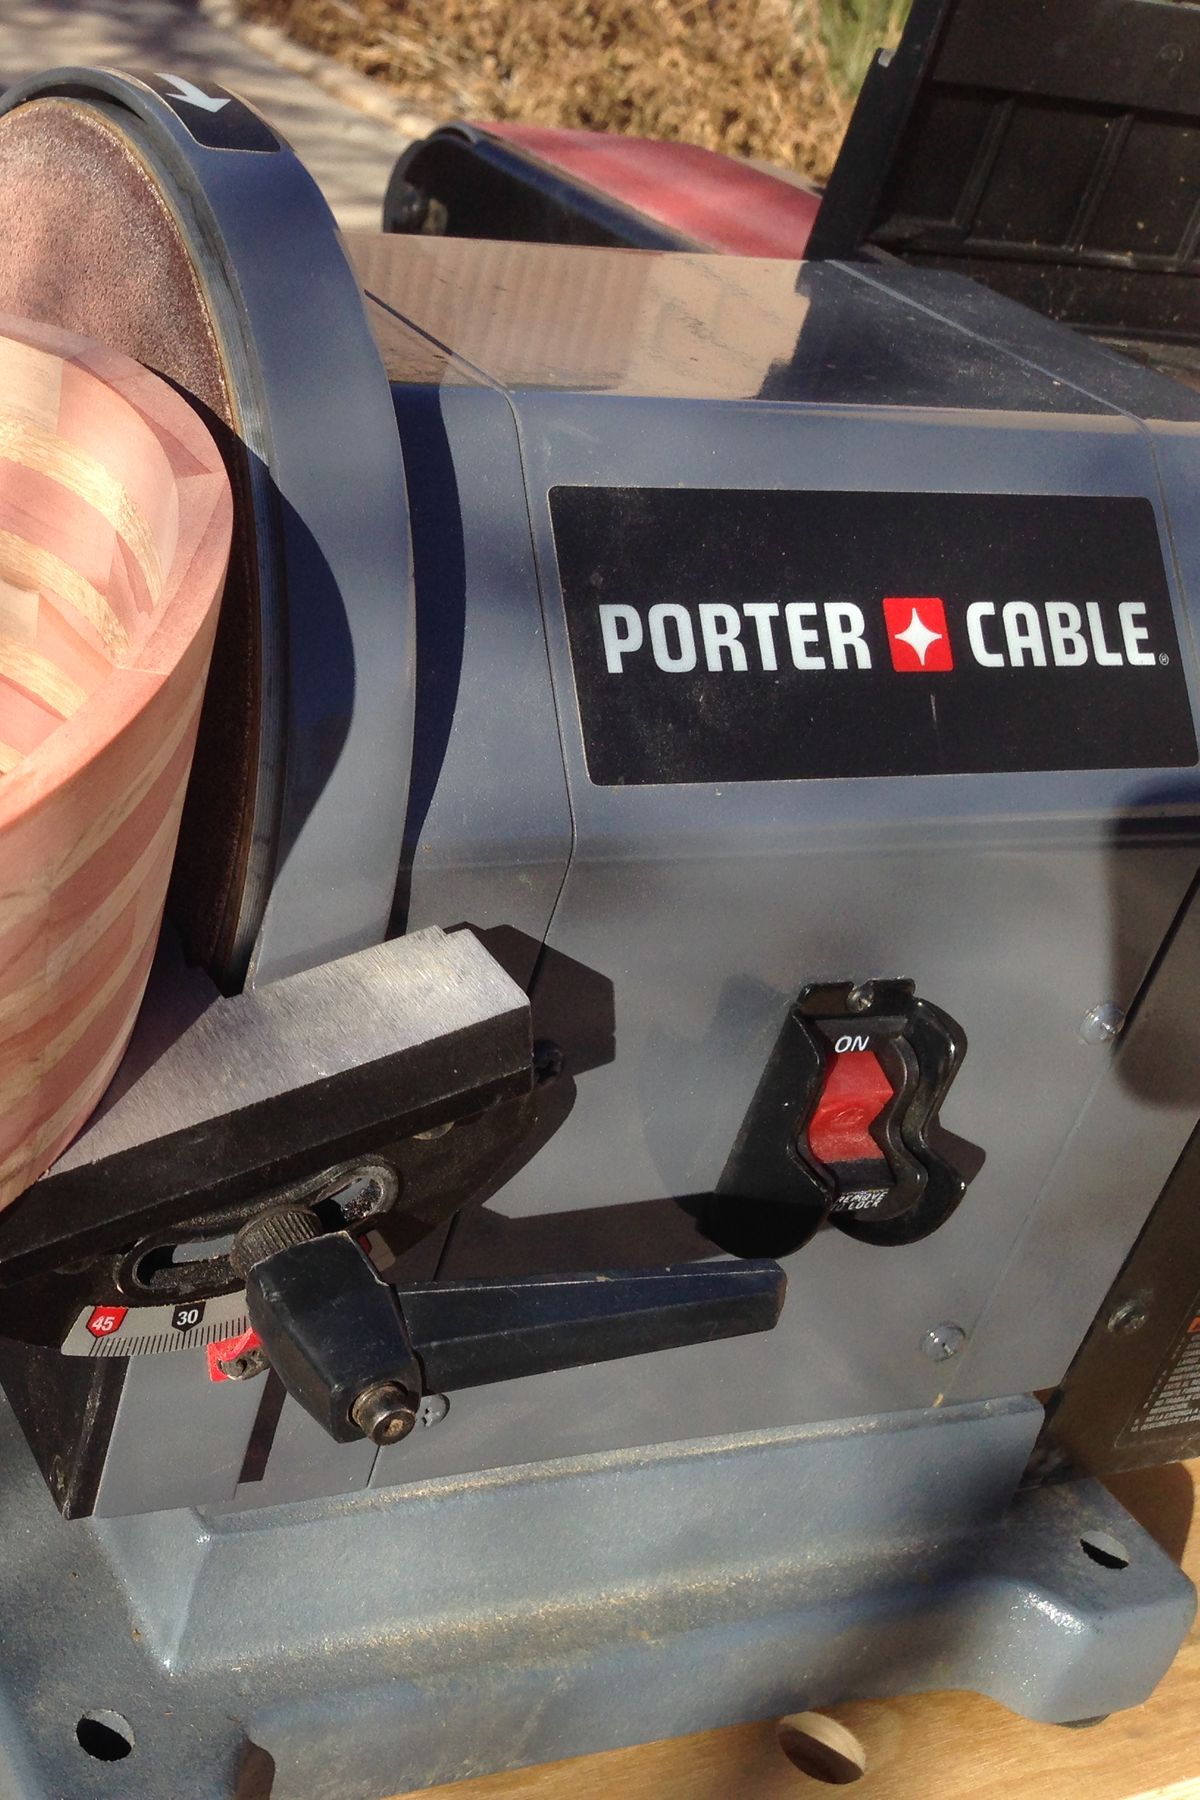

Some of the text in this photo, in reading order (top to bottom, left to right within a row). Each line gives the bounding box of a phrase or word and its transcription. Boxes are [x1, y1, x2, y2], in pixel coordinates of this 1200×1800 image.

[600, 602, 1155, 673] PORTER CABLE
[835, 1036, 869, 1053] ON
[847, 1199, 881, 1211] LOCK
[92, 1316, 115, 1331] 45
[177, 1310, 198, 1326] 30
